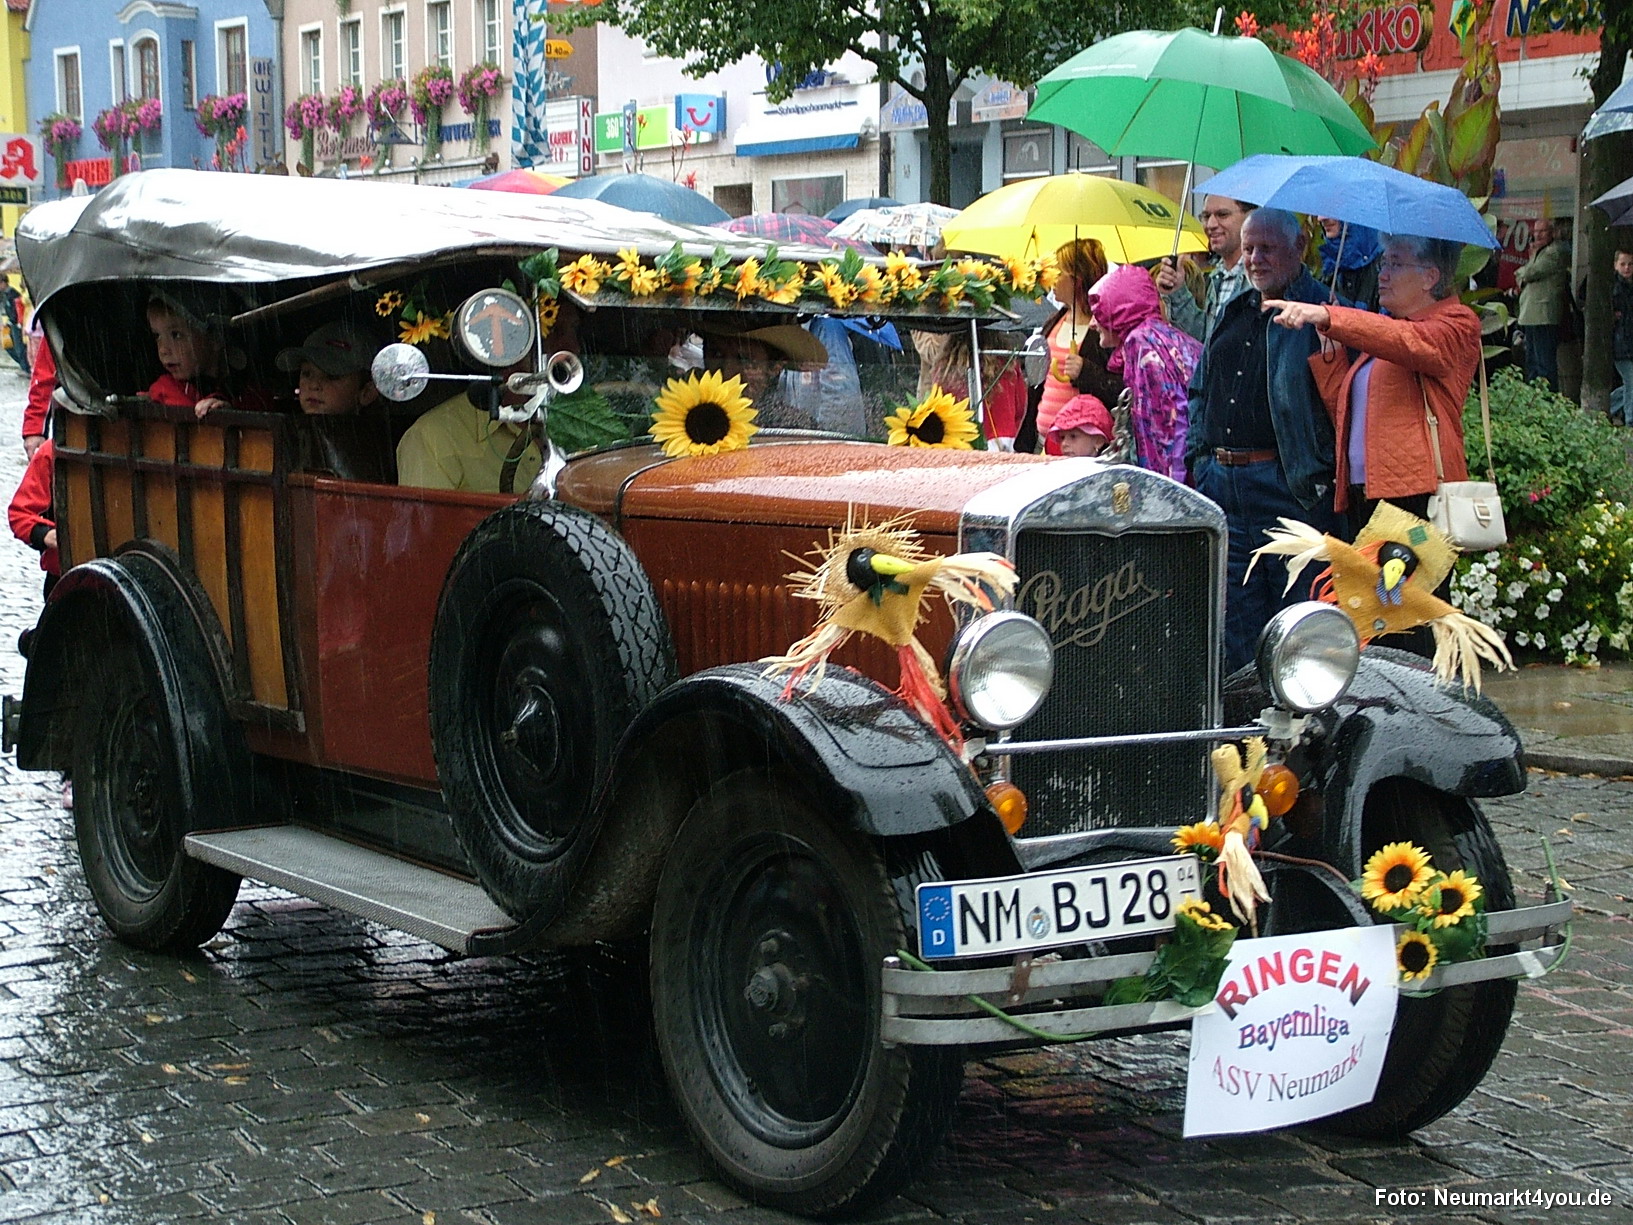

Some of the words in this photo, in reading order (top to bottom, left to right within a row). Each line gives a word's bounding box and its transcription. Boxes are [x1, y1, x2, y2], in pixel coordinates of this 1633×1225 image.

[1337, 4, 1423, 58] KKO
[255, 79, 272, 160] WITTL
[581, 100, 592, 172] KINO
[1015, 561, 1158, 649] Praga
[1177, 865, 1195, 882] 04
[932, 929, 946, 946] D
[958, 887, 1022, 946] NM
[1215, 948, 1371, 1021] RINGEN
[1238, 1003, 1350, 1051] Bayernliga
[1212, 1055, 1262, 1101] ASV
